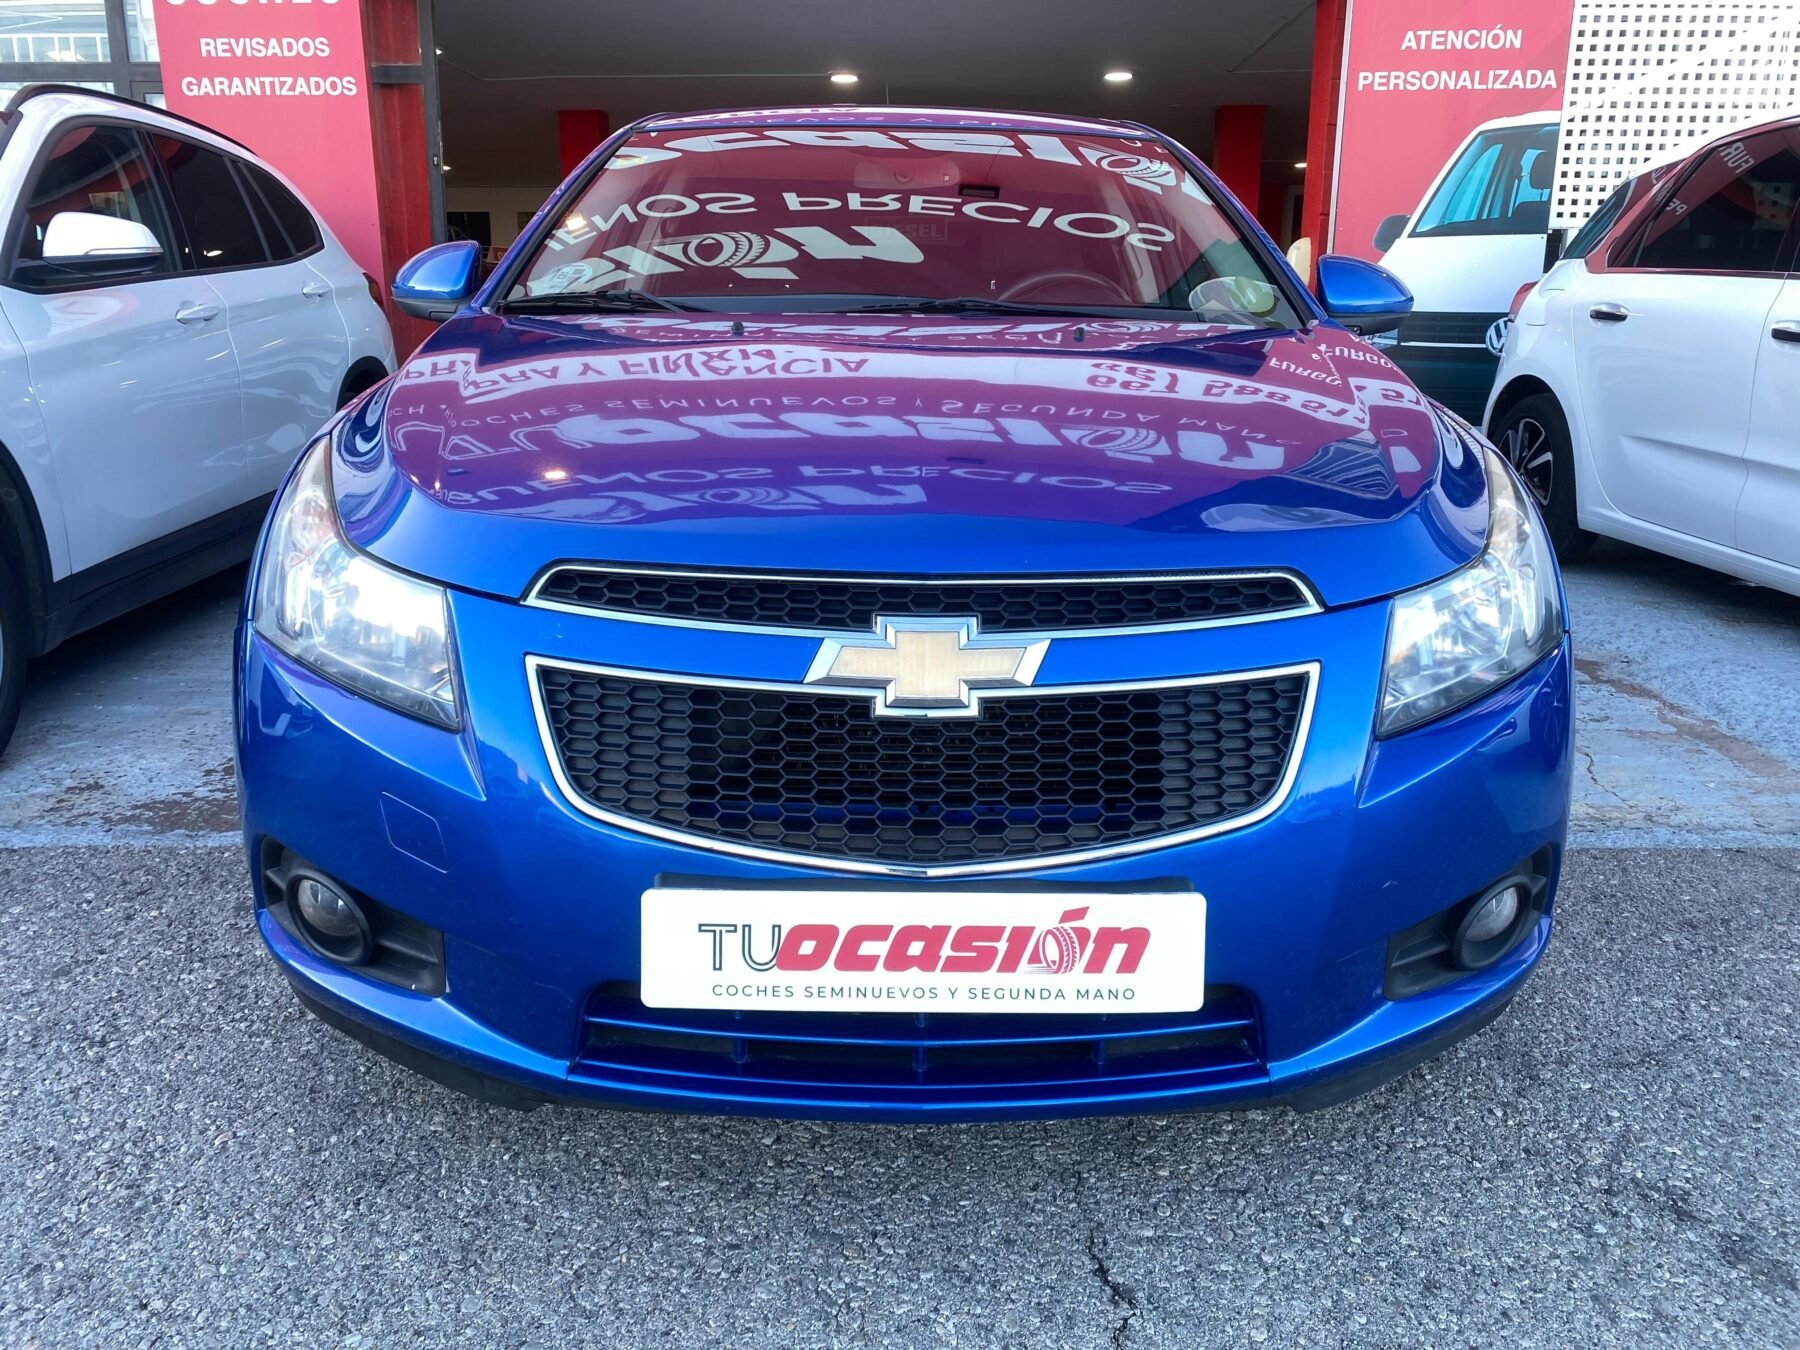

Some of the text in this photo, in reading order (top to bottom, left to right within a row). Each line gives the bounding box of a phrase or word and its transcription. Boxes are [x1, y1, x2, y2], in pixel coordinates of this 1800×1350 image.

[200, 37, 330, 58] REVISADOS
[1400, 24, 1523, 51] ATENCIÓN
[181, 76, 358, 98] GARANTIZADOS
[1357, 69, 1558, 92] PERSONALIZADA
[712, 983, 1137, 1001] COCHES SEMINUEVOS Y SEGUNDA MANO
